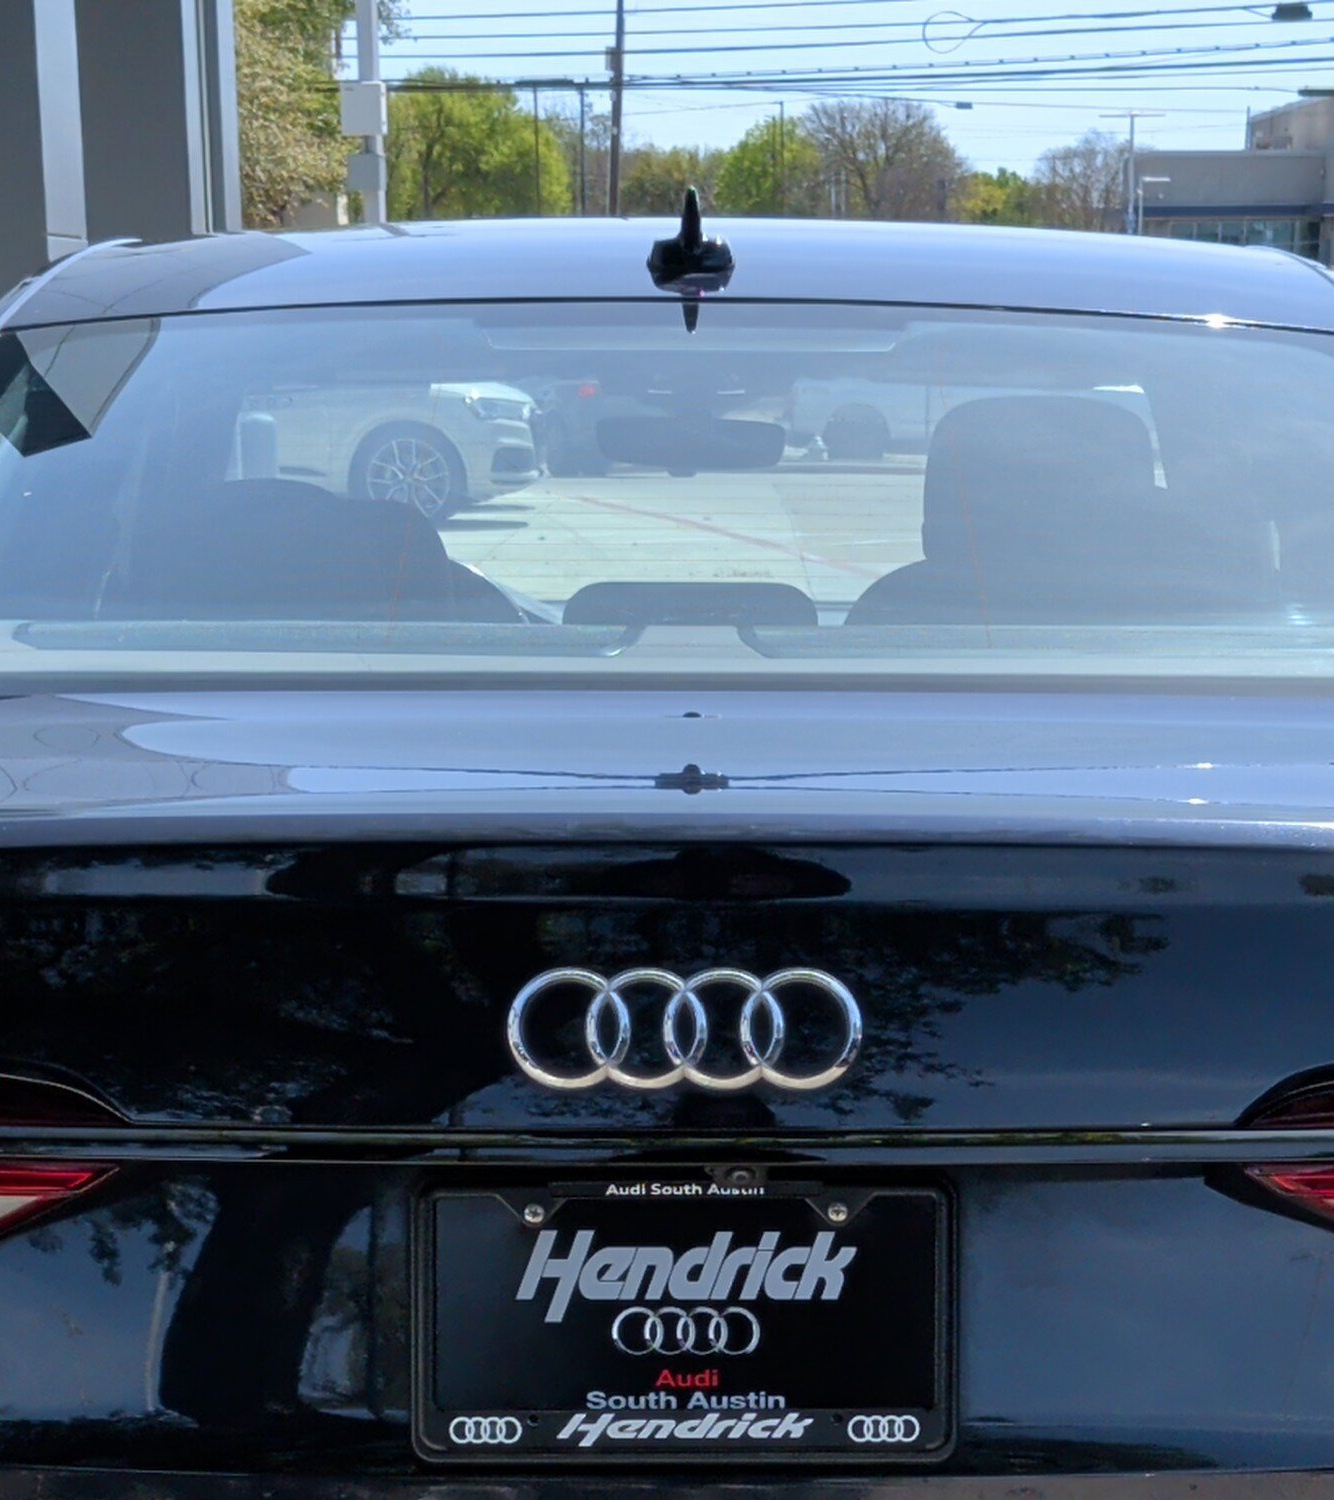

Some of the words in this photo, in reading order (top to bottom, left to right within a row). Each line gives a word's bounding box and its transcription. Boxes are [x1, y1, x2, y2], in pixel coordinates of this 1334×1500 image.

[605, 1183, 646, 1196] Audi
[651, 1183, 703, 1196] South
[516, 1230, 857, 1322] Hendrick
[655, 1370, 719, 1388] Audi
[586, 1391, 678, 1410] South
[687, 1391, 786, 1410] Austin
[557, 1413, 814, 1447] Hendrick
